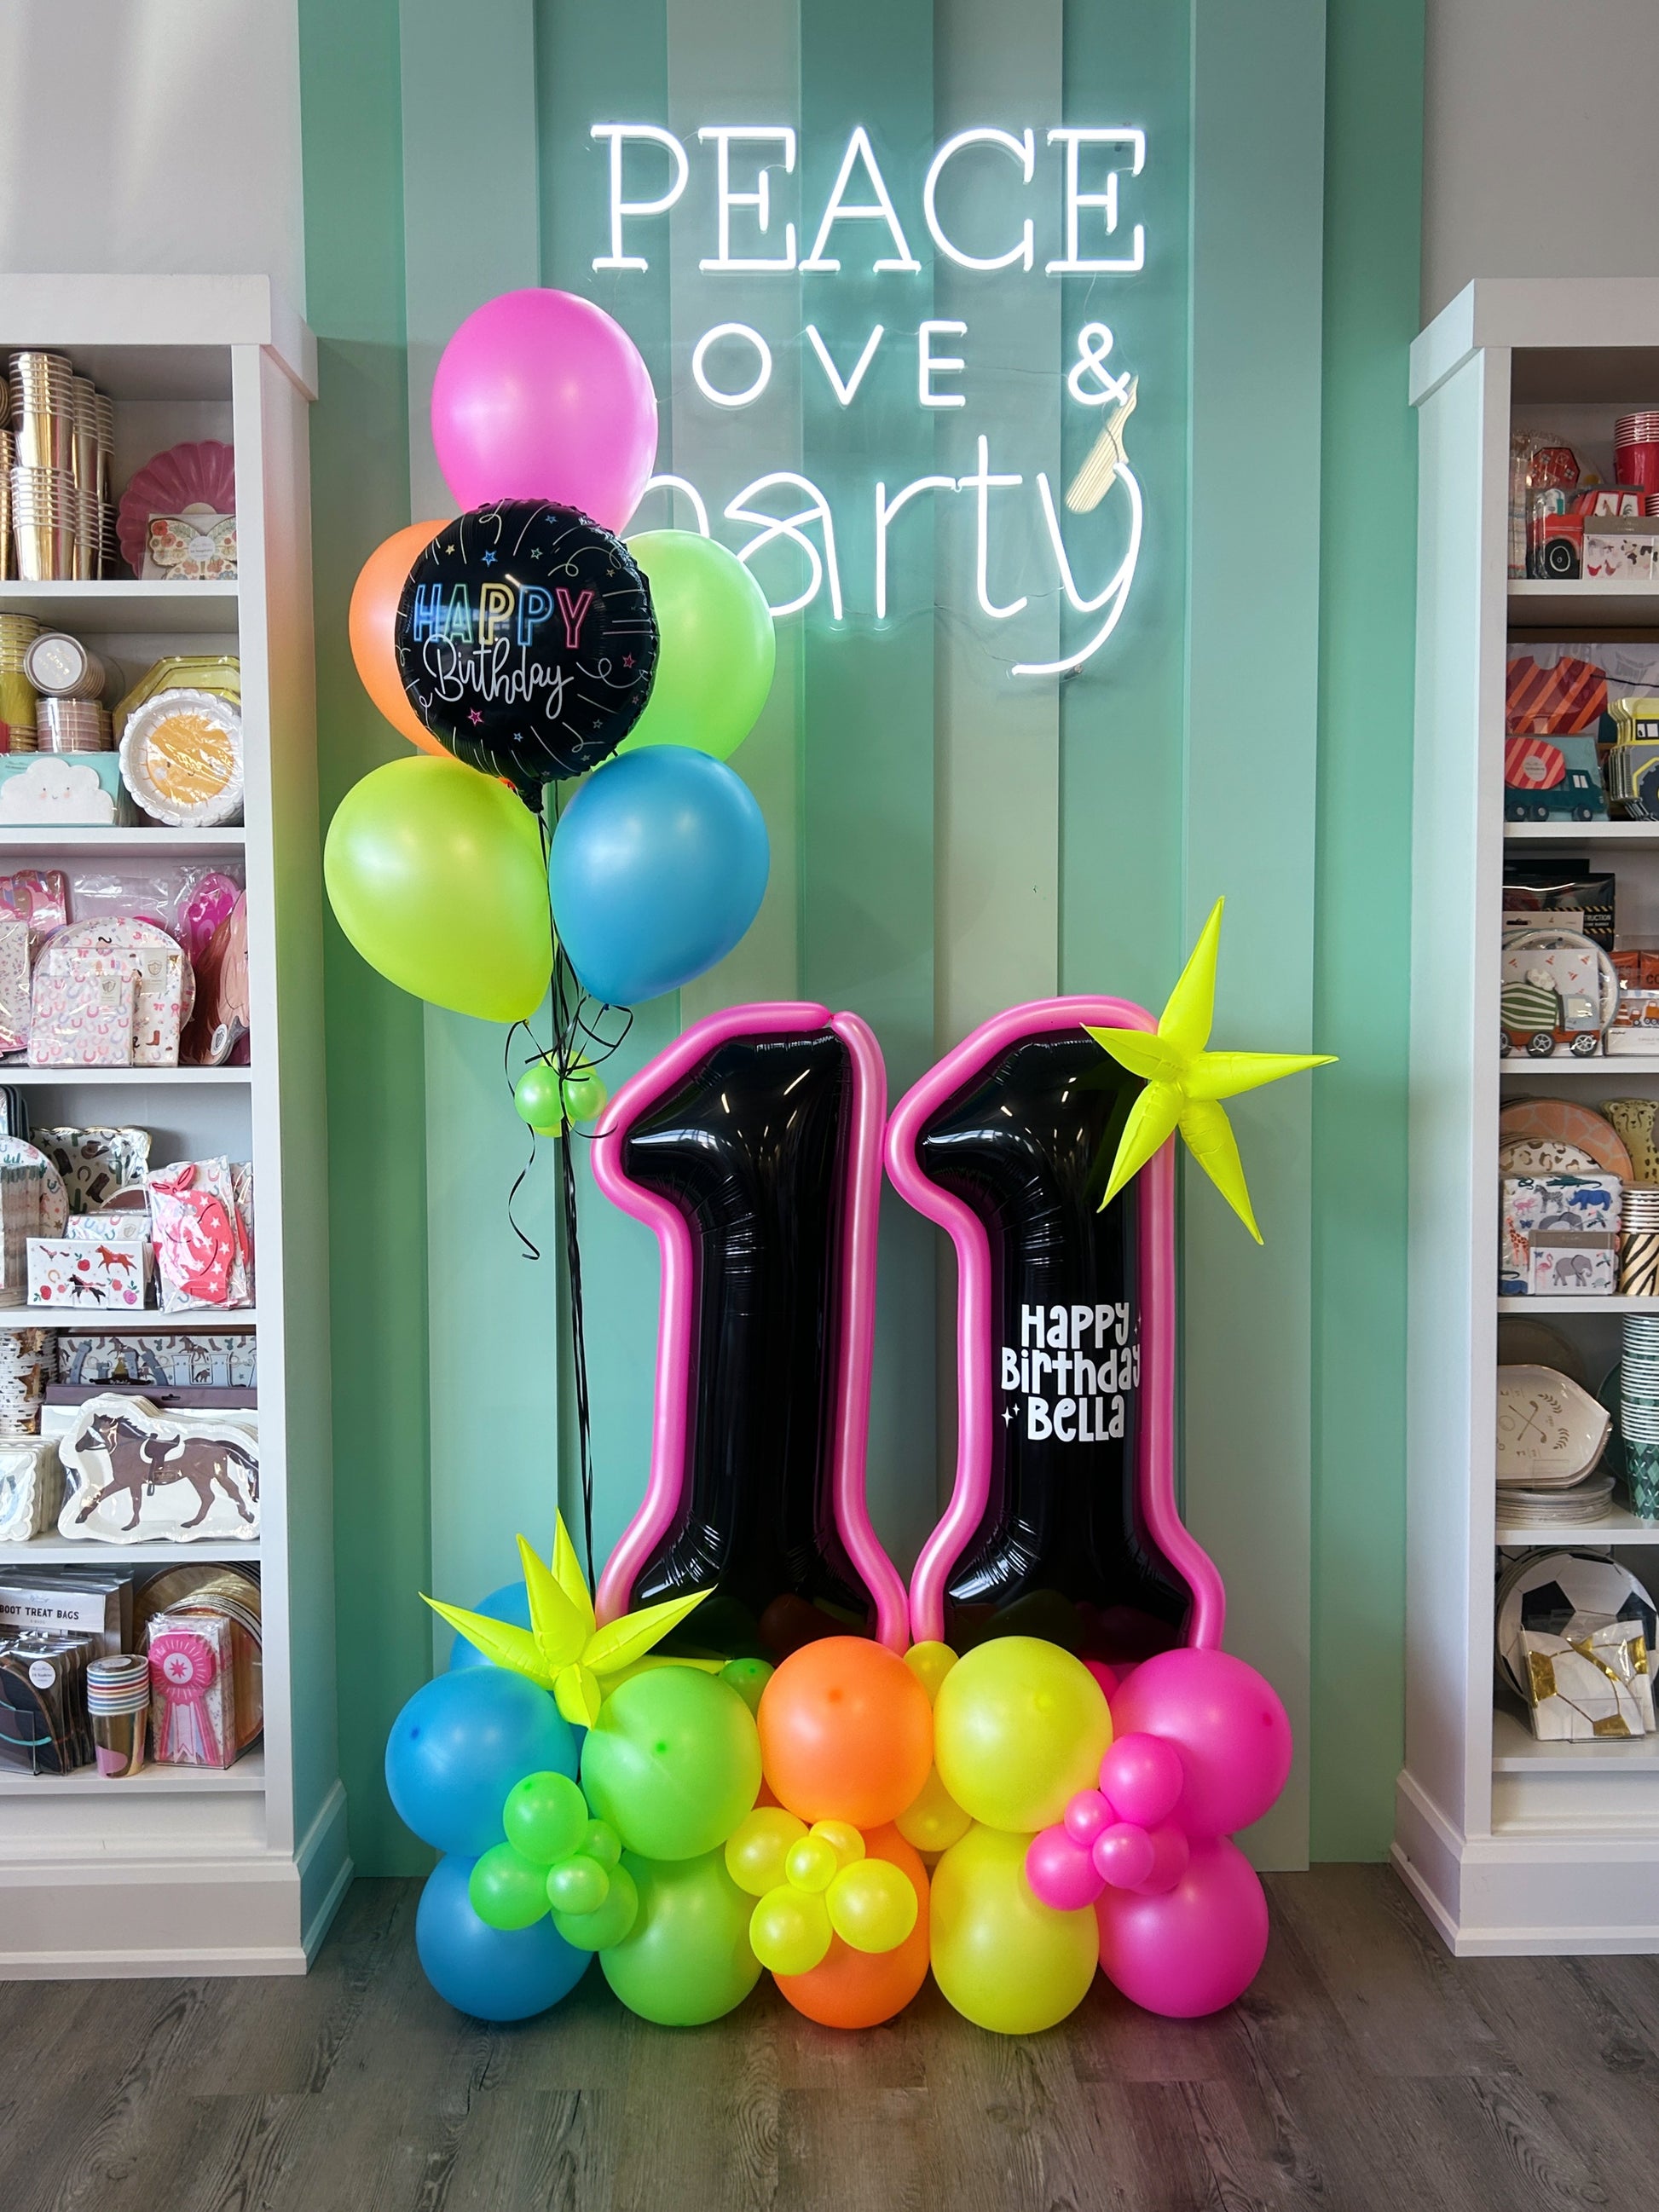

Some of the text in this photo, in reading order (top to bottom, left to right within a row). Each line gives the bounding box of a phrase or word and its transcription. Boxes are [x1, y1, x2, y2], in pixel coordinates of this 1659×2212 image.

[590, 124, 1146, 274] PEACE
[692, 321, 1132, 408] OVE &
[413, 582, 595, 650] HAPPY
[422, 633, 575, 720] Birthday
[1001, 1343, 1141, 1395] Birthday
[0, 1604, 80, 1620] BOOT TREAT BAGS
